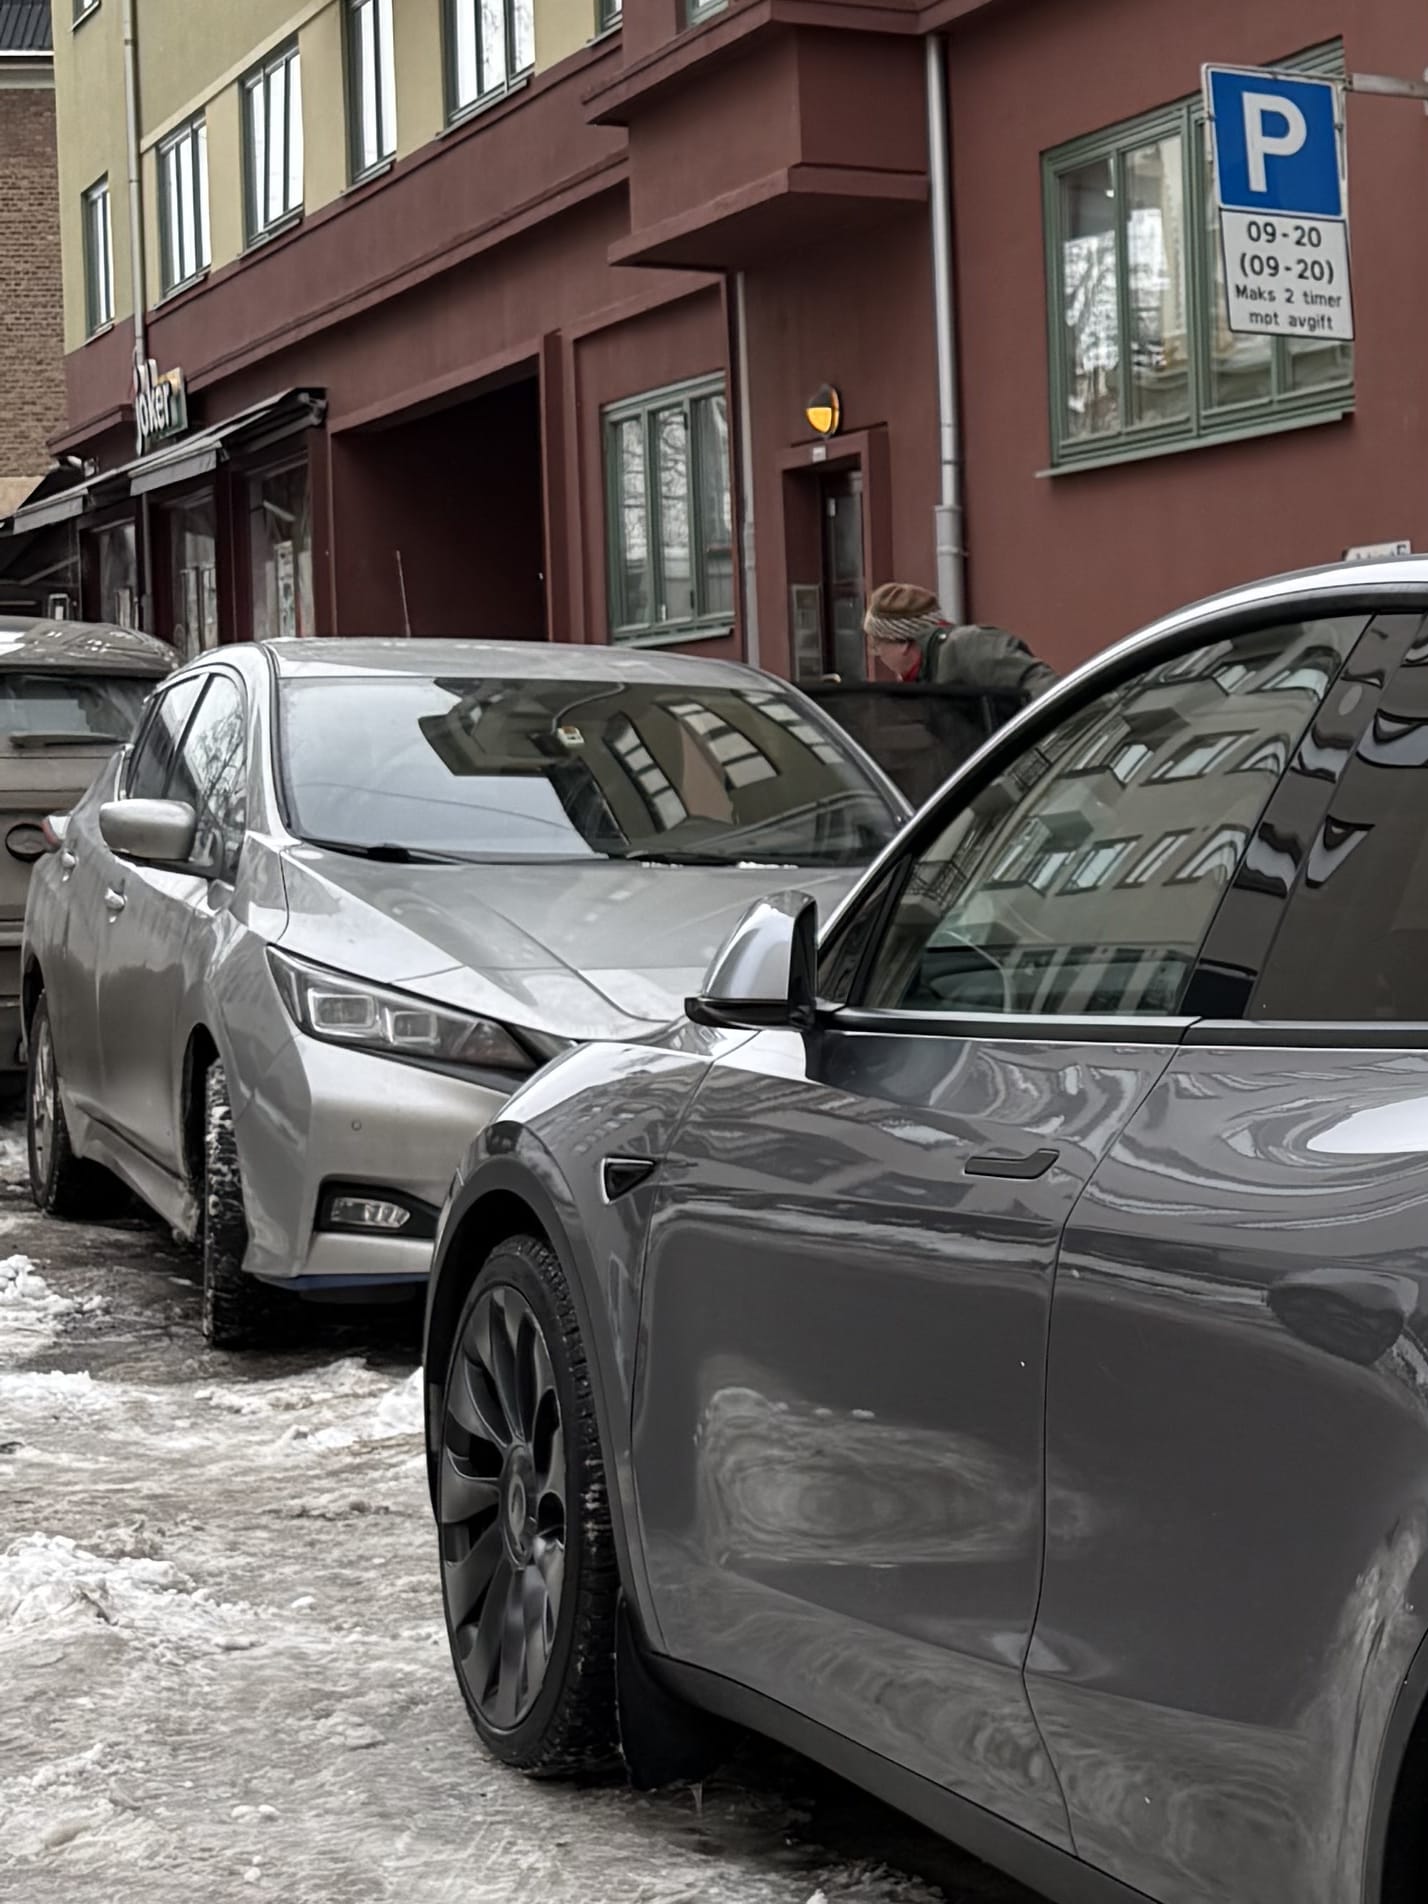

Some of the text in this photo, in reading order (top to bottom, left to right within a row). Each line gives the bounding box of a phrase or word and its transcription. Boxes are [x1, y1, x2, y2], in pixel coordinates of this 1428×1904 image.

[1241, 91, 1307, 193] P
[1247, 220, 1322, 248] 09-20
[1240, 252, 1335, 285] (09-20)
[1235, 284, 1342, 308] Maks 2 timer
[1249, 309, 1334, 332] mot avgift
